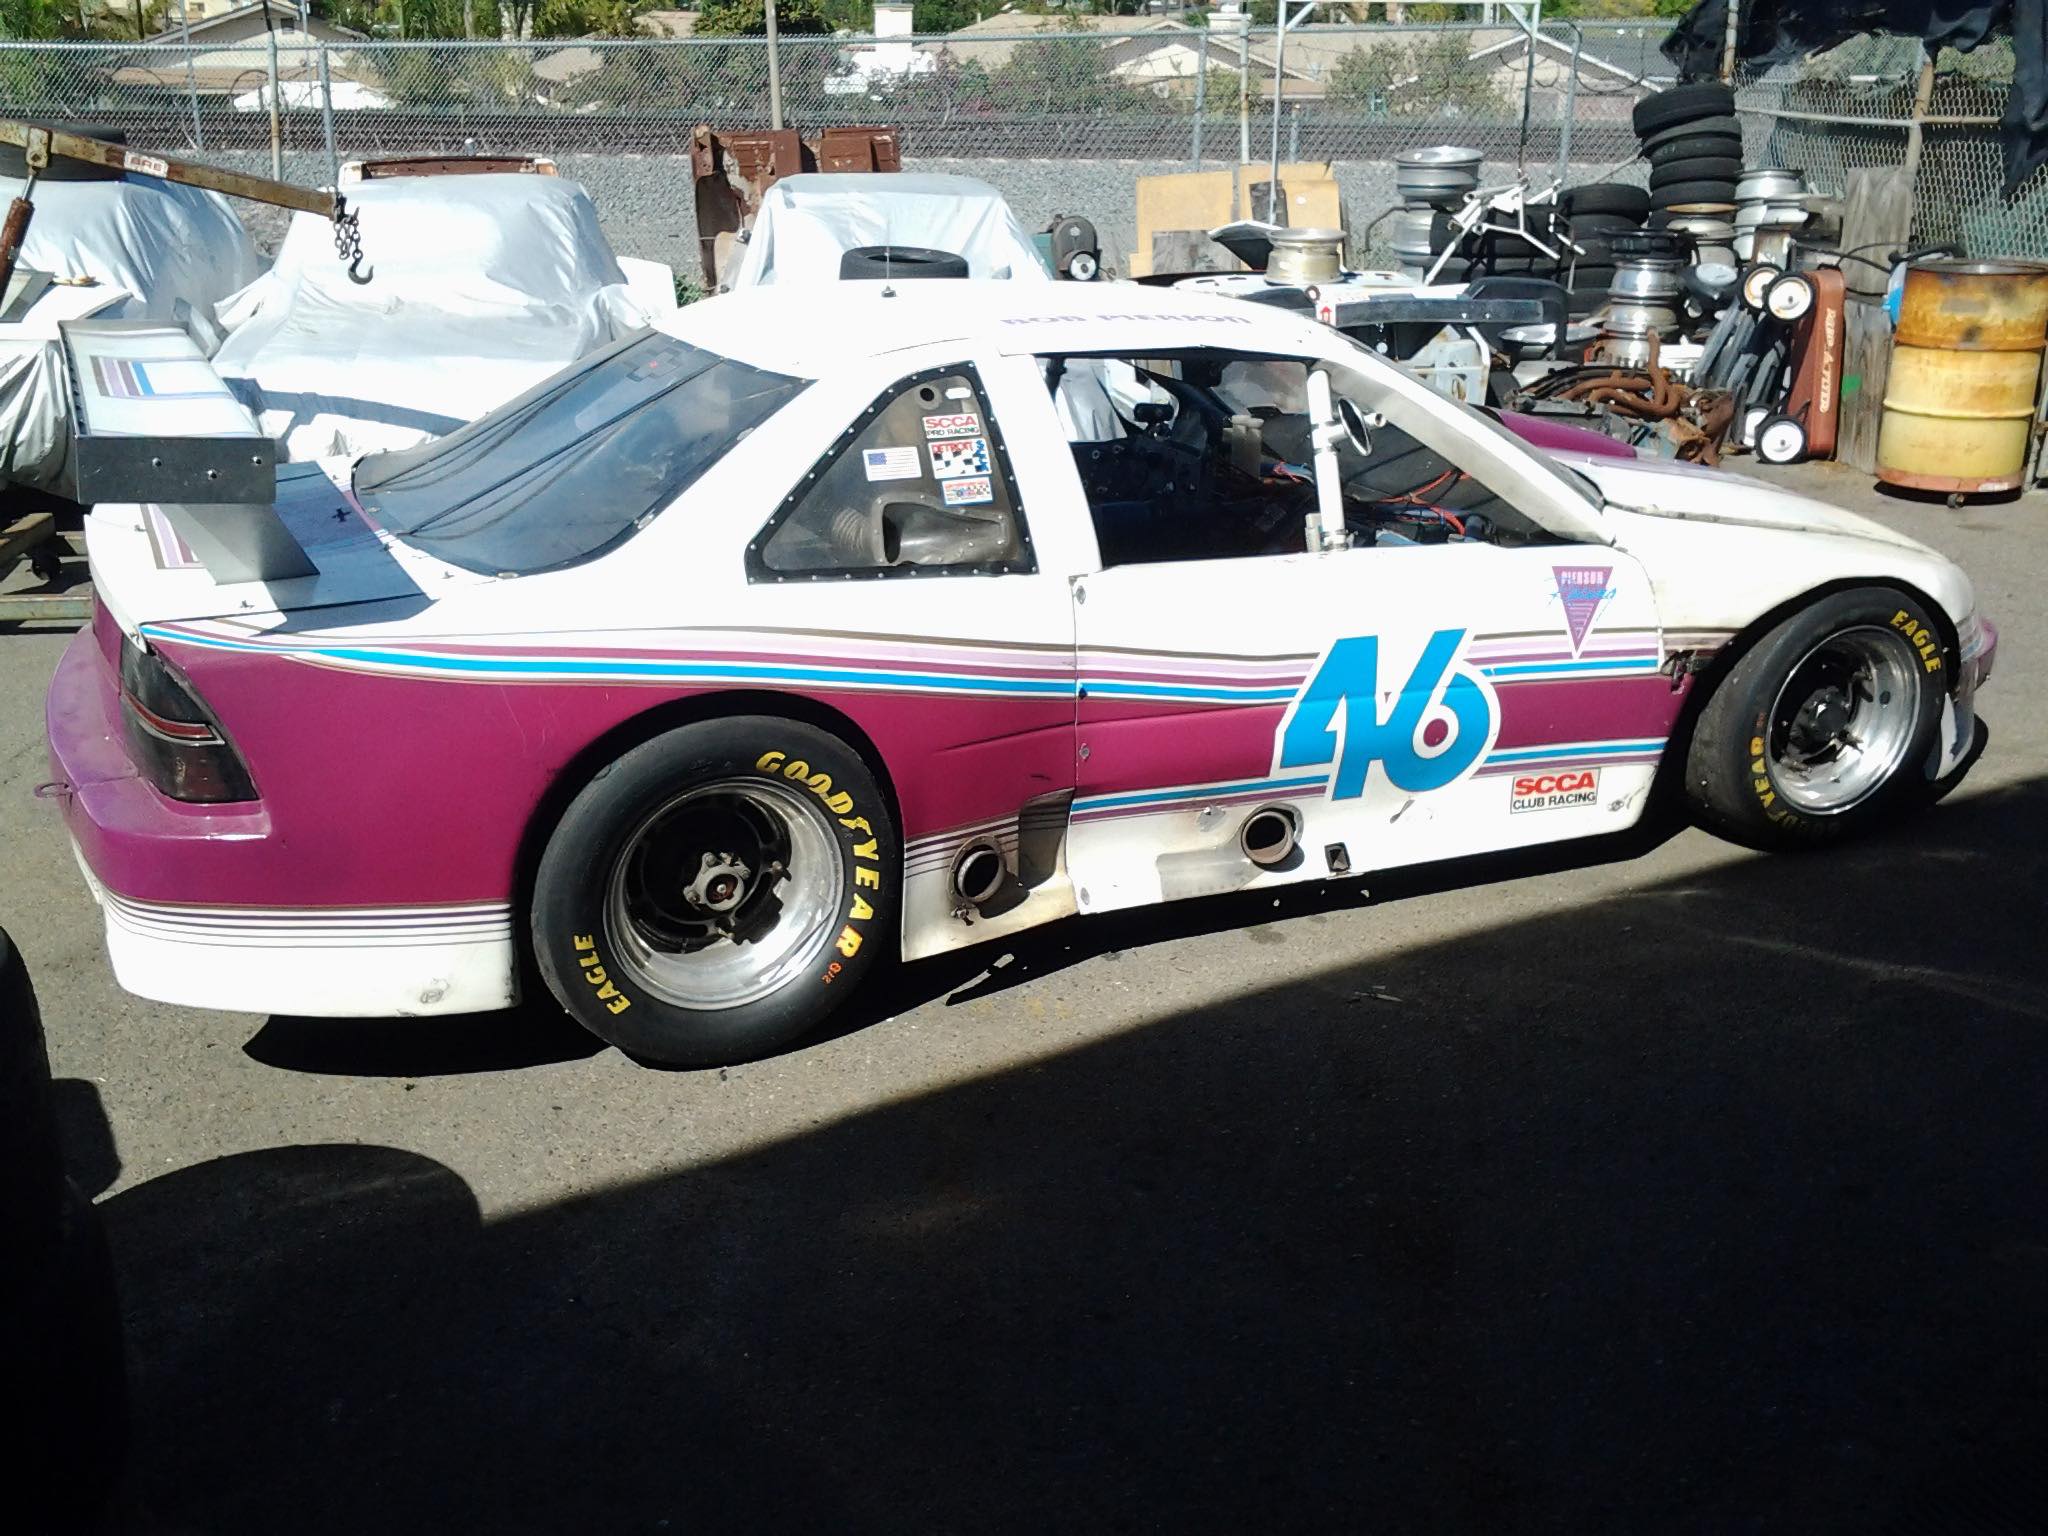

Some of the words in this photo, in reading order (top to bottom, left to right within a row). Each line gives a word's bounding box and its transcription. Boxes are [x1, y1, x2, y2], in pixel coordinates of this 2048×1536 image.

[925, 415, 977, 429] SCCA
[1890, 609, 1941, 674] EAGLE
[1280, 628, 1490, 801] 46
[1513, 798, 1545, 810] CLUB
[1548, 791, 1596, 806] RACING
[1515, 772, 1595, 796] SCCA
[756, 751, 880, 958] GOODYEAR
[573, 934, 631, 1015] EAGLE
